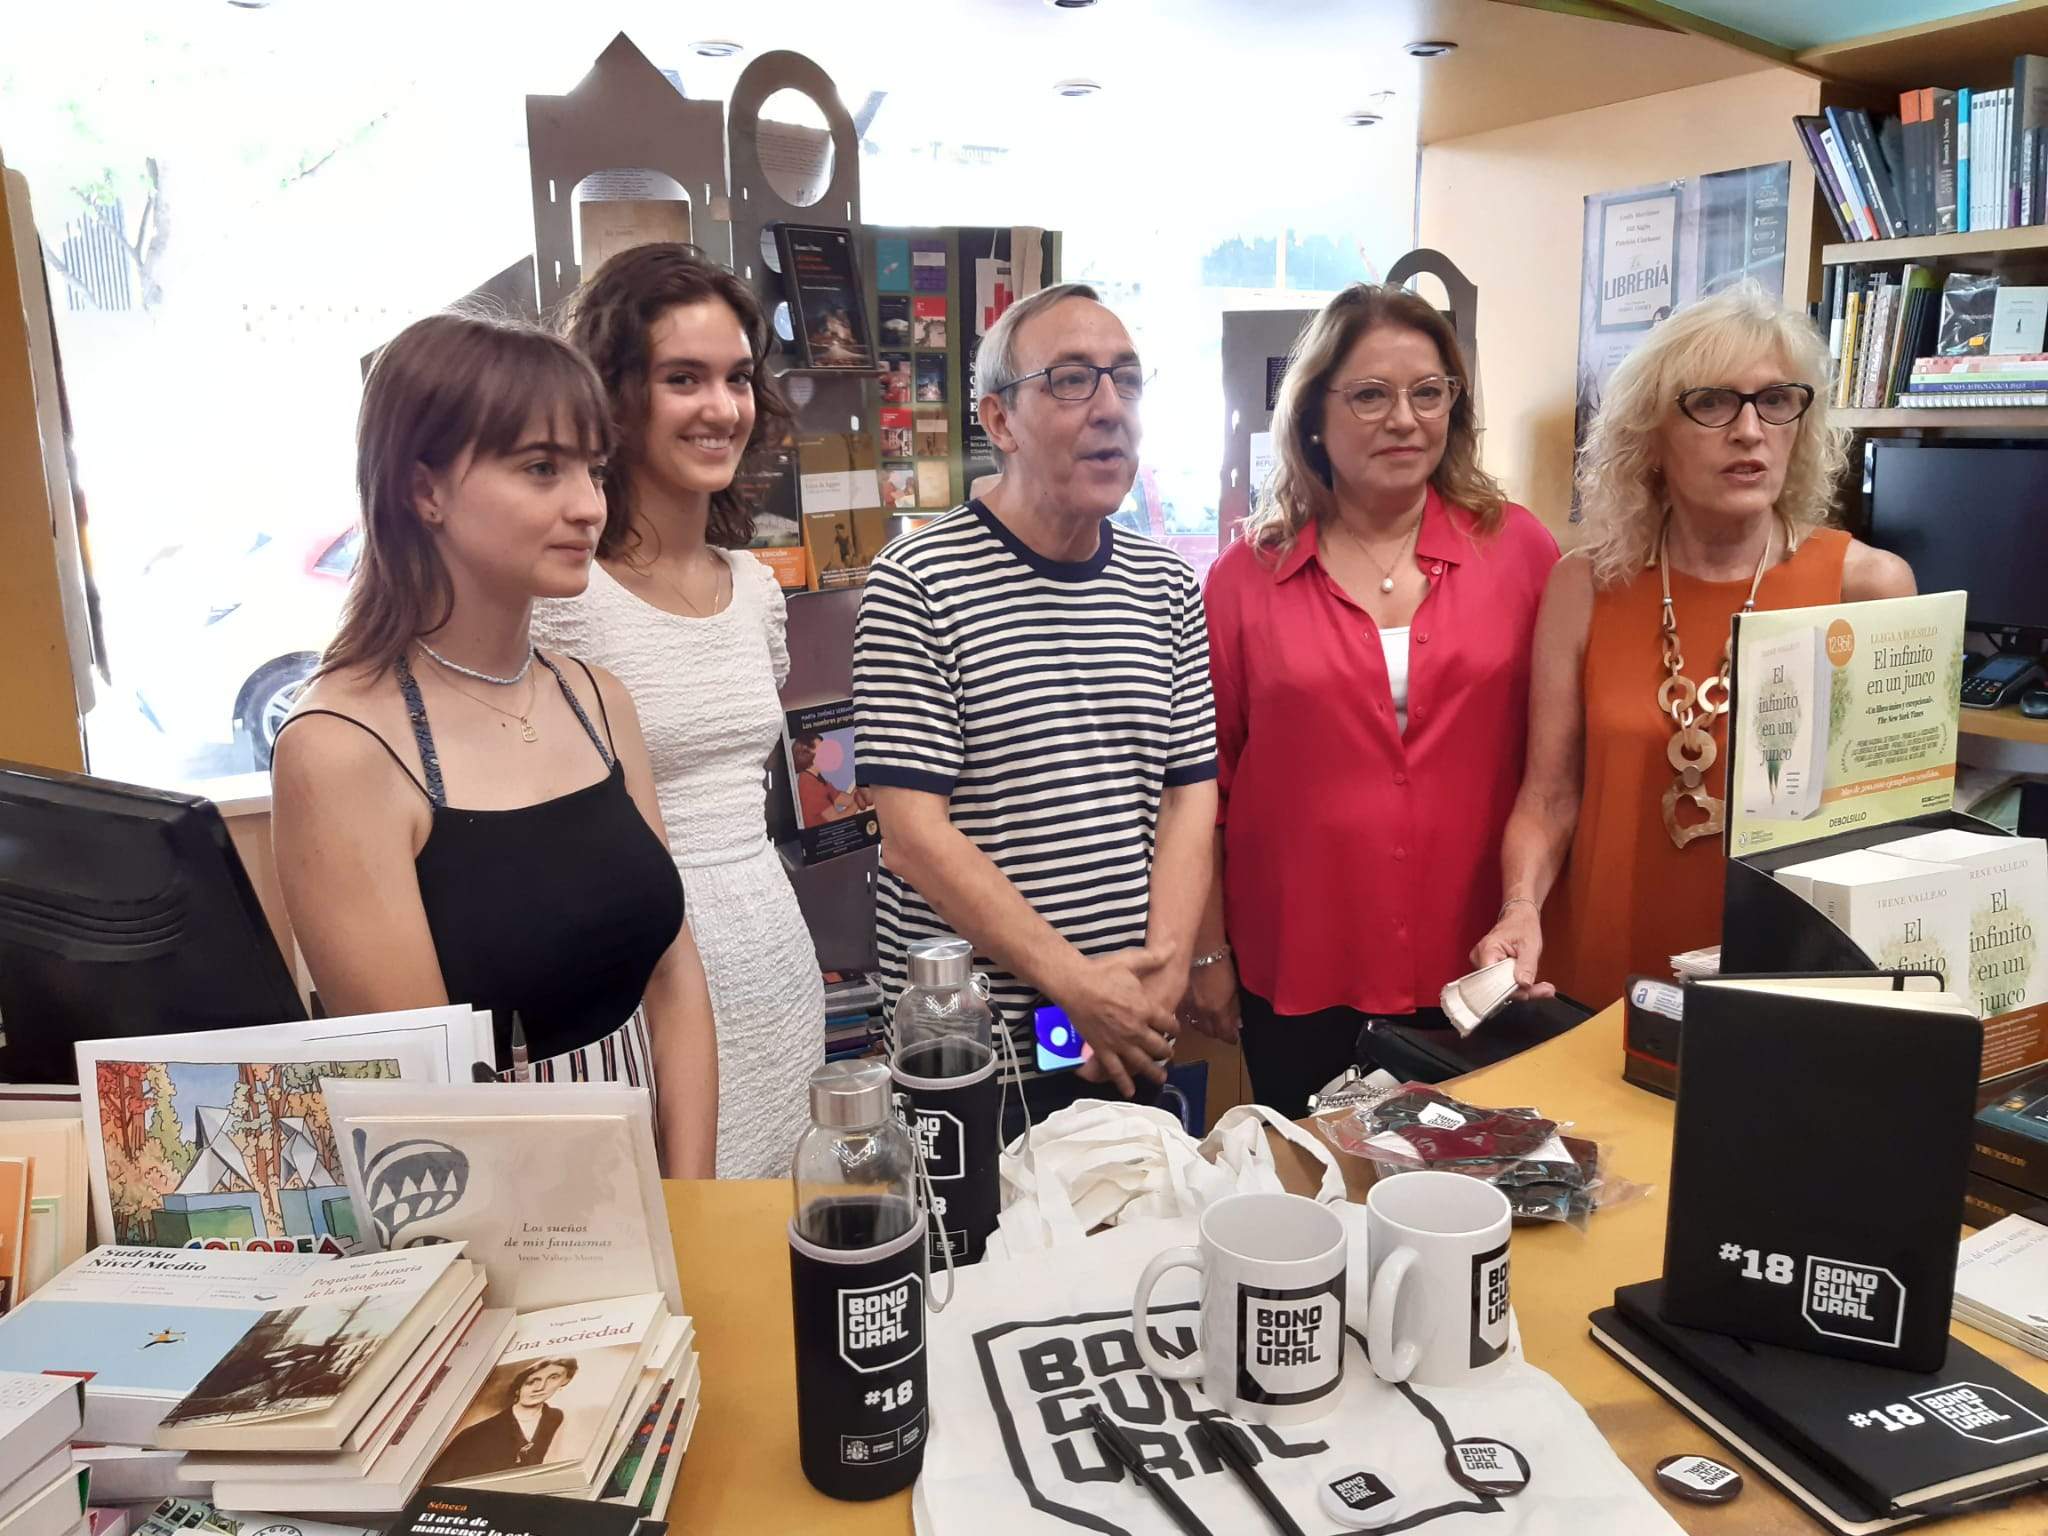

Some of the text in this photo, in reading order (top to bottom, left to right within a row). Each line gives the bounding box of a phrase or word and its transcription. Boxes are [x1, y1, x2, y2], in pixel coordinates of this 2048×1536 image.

[1604, 260, 1669, 301] LIBRERÍA
[1873, 644, 1933, 670] El infinito
[1772, 665, 1785, 684] El
[1866, 669, 1936, 695] en un junco
[1758, 692, 1799, 713] infinito
[1762, 720, 1793, 736] en un
[1877, 710, 1924, 725] The New York Times
[1760, 744, 1792, 766] junco
[1829, 811, 1868, 828] DEBOLSILLO
[1969, 859, 2029, 881] RENE VALLEJO
[1877, 888, 1947, 909] IRENE VALLEJO
[1990, 888, 2009, 914] El
[1903, 918, 1922, 945] El
[1969, 922, 2032, 954] infinito
[1978, 956, 2025, 982] en un
[1977, 987, 2026, 1020] junco
[522, 1221, 588, 1233] Los sueños
[101, 1247, 178, 1260] Sudoku
[503, 1237, 613, 1250] de mis fantasmas
[87, 1257, 208, 1272] Nivel Medio
[1488, 1259, 1510, 1288] BO
[1718, 1242, 1794, 1285] #18
[312, 1264, 424, 1287] Pequeña historia
[1815, 1264, 1879, 1291] BONO
[304, 1277, 407, 1299] de la fotografía
[1488, 1279, 1510, 1306] CU
[1813, 1280, 1876, 1305] CULT
[849, 1285, 909, 1315] BONO
[1812, 1295, 1875, 1322] URAL
[849, 1302, 908, 1333] CULT
[1256, 1304, 1322, 1329] BONO
[502, 1322, 635, 1354] Una sociedad
[849, 1323, 910, 1350] URAL
[1256, 1324, 1321, 1348] CULT
[1019, 1326, 1200, 1393] BON
[1256, 1345, 1322, 1367] URAL
[864, 1379, 914, 1413] #18
[1922, 1387, 1980, 1410] BONO
[1847, 1403, 1926, 1432] #18
[1938, 1397, 1991, 1421] CULT
[1952, 1411, 2013, 1431] URAL
[1460, 1447, 1497, 1455] BONO
[1463, 1454, 1497, 1463] CULT
[1465, 1461, 1504, 1470] URAL
[1683, 1460, 1711, 1475] URAL
[1697, 1464, 1721, 1480] CULT
[1335, 1475, 1366, 1492] BONO
[1703, 1470, 1731, 1486] BONO
[1341, 1482, 1368, 1498] CULT
[1347, 1489, 1377, 1504] URAL
[427, 1501, 468, 1511] Séneca
[410, 1524, 486, 1536] mantener
[418, 1513, 489, 1527] El arte de
